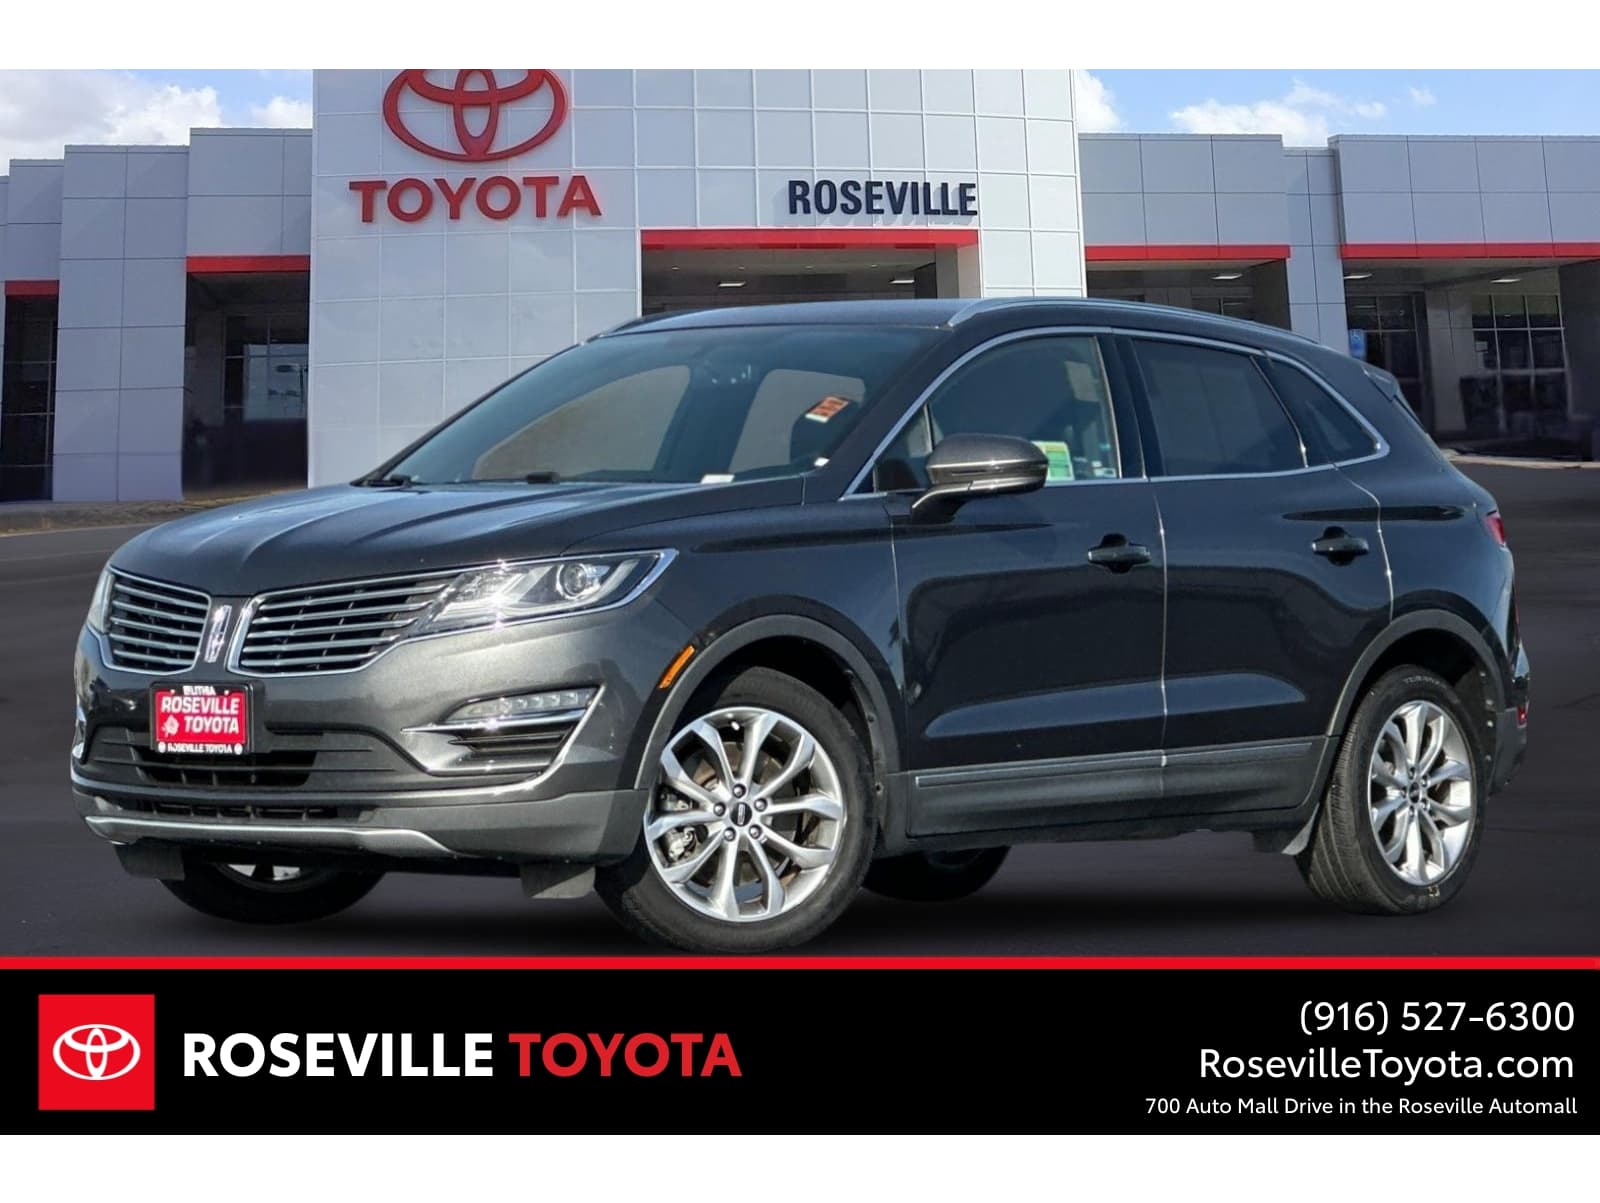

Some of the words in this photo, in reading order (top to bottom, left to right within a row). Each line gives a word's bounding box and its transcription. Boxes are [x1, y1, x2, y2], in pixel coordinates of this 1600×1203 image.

[349, 175, 602, 223] TOYOTA
[788, 179, 979, 216] ROSEVILLE
[161, 696, 240, 715] ROSEVILLE
[184, 715, 240, 734] TOYOTA
[167, 742, 204, 753] ROSEVILLE
[204, 743, 233, 754] TOYOTA
